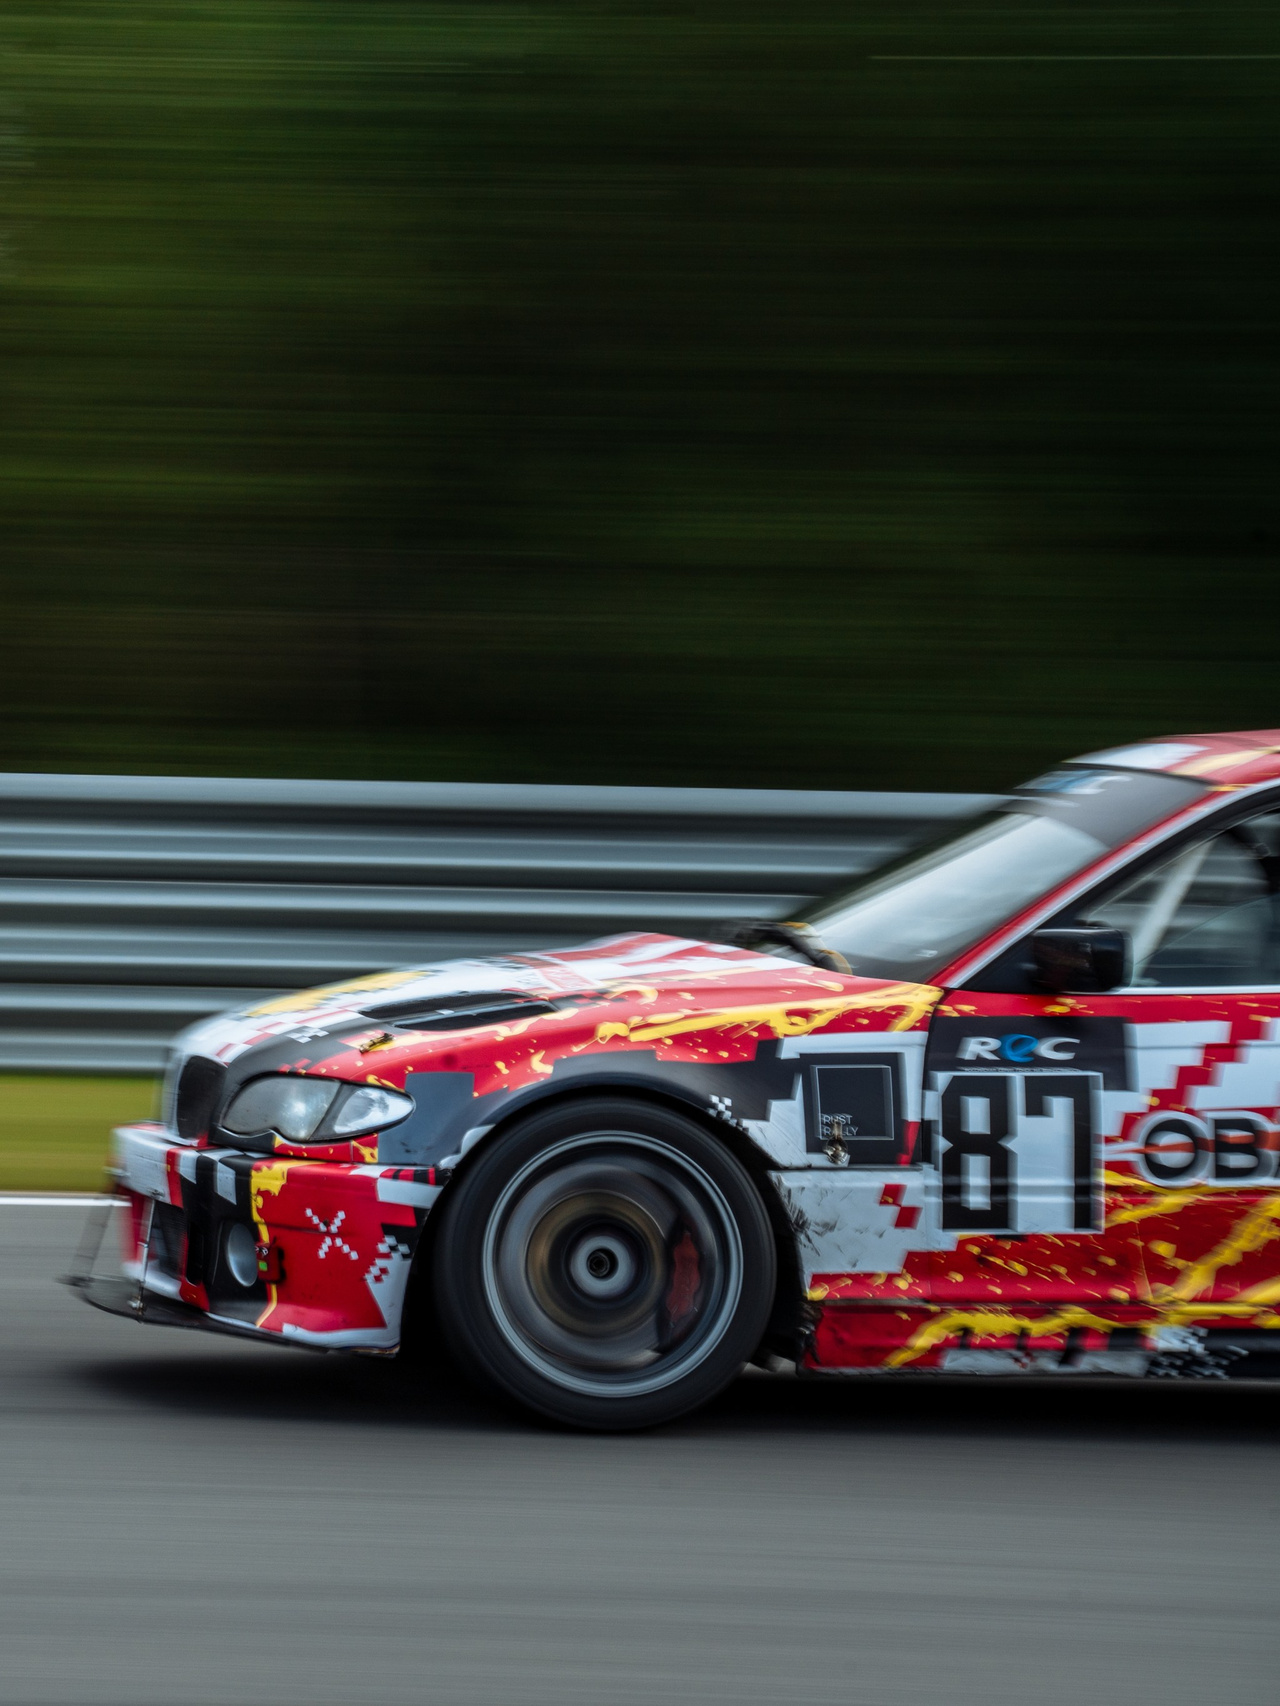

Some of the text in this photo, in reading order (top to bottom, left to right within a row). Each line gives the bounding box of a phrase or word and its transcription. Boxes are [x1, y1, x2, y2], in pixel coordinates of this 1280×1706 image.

[821, 1113, 853, 1125] RUST
[821, 1125, 859, 1136] RLY
[936, 1073, 1096, 1232] 87
[1142, 1116, 1280, 1182] OB
